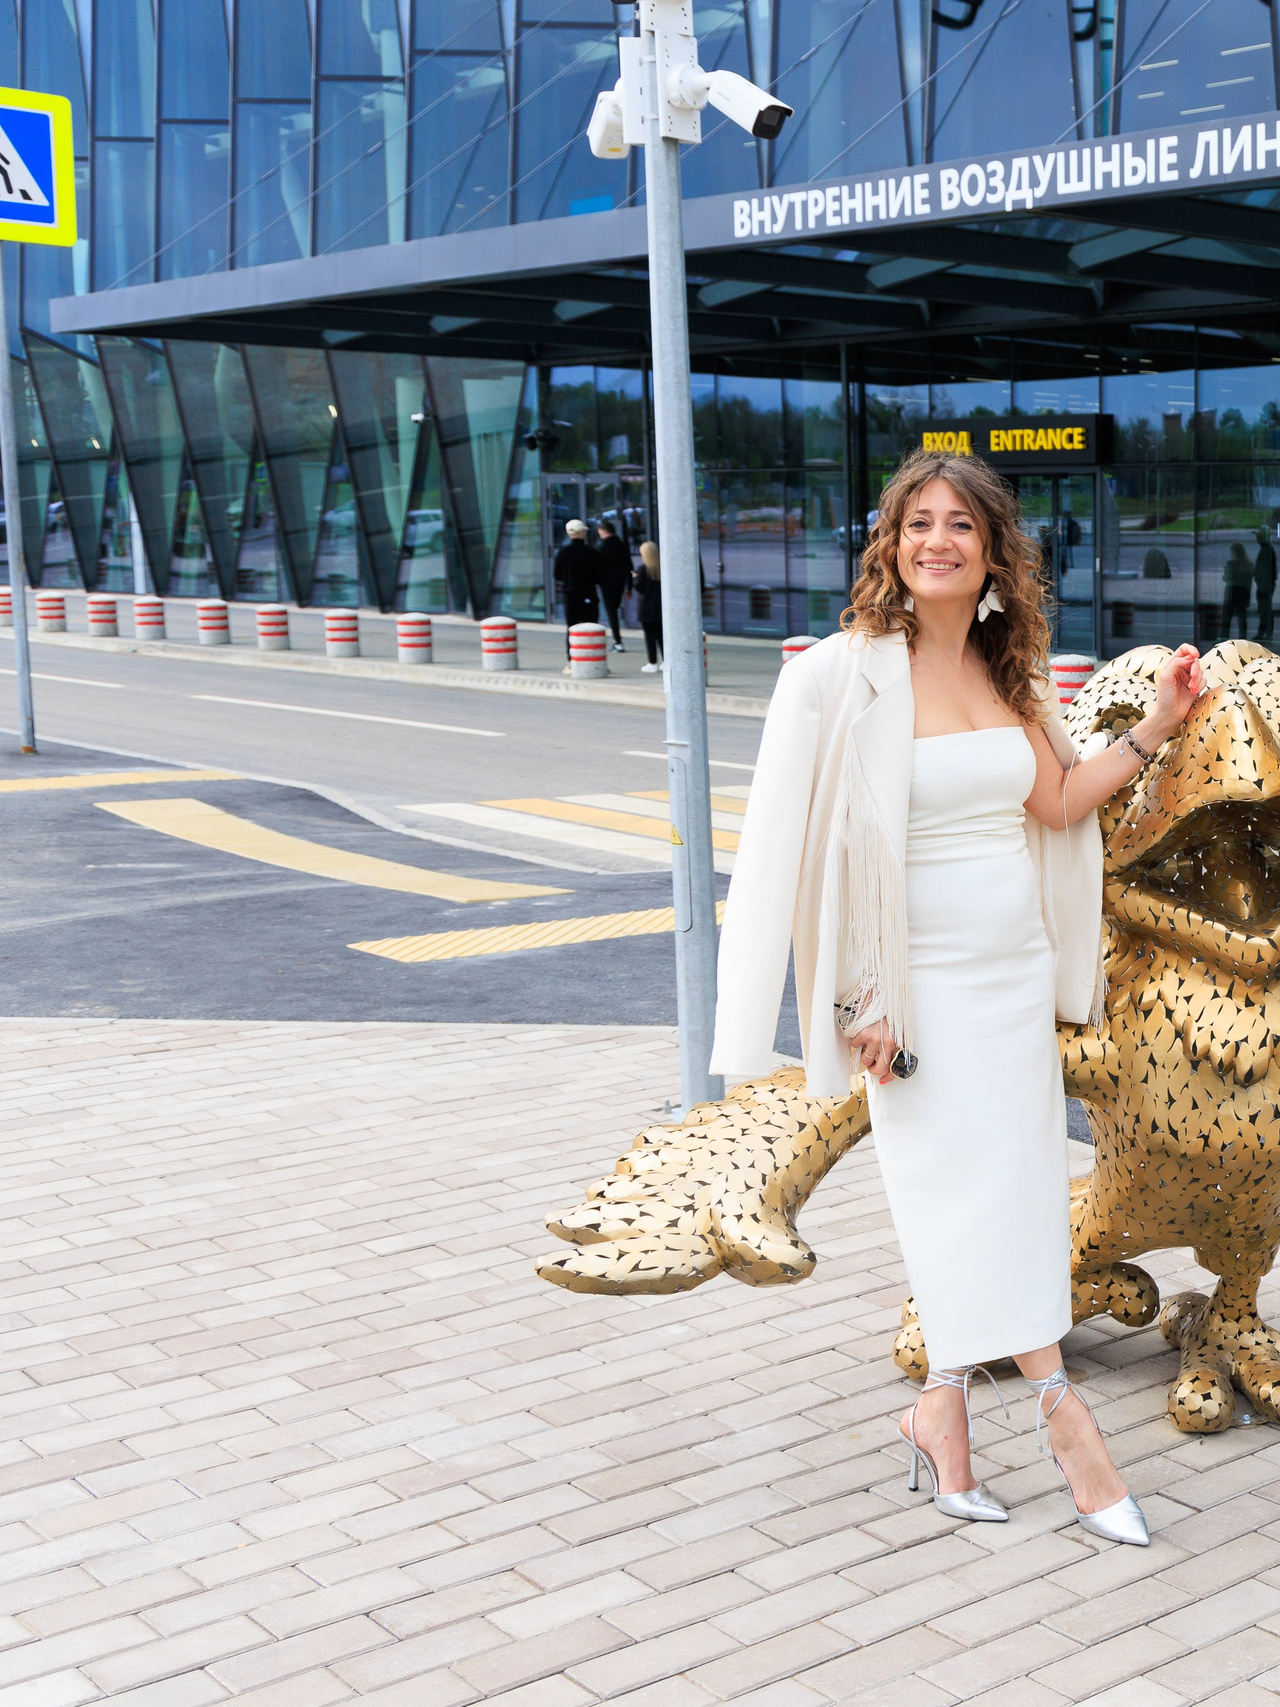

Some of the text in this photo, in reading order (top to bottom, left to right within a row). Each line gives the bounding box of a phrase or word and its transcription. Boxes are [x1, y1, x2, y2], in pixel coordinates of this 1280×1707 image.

[733, 173, 931, 238] ВНУТРЕННИЕ
[939, 135, 1179, 212] ВОЗДУШНЫЕ
[922, 431, 973, 456] ВХОД
[990, 427, 1086, 452] ENTRANCE
